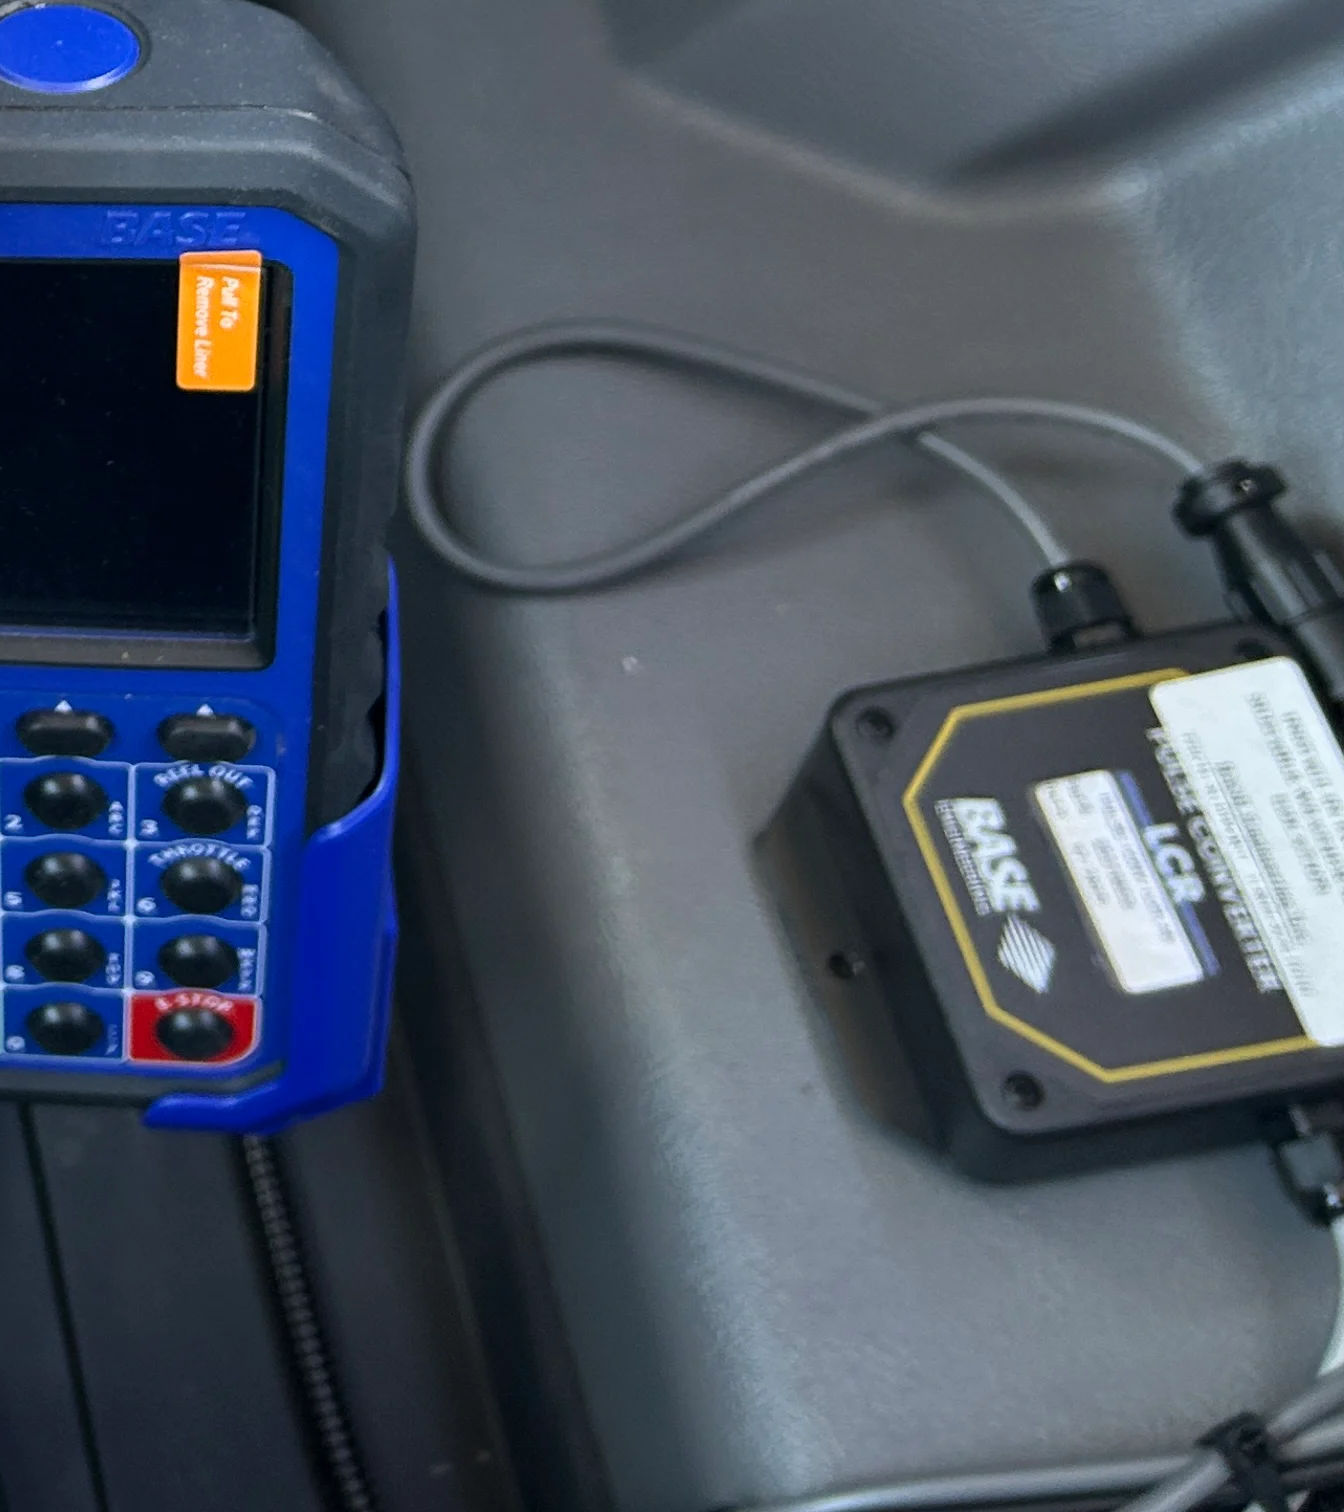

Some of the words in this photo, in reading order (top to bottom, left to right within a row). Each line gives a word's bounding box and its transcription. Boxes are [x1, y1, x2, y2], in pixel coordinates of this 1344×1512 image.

[100, 210, 246, 247] BASE
[194, 276, 214, 336] Remove
[220, 276, 240, 308] Pull
[219, 310, 238, 330] To
[192, 338, 212, 378] Liner
[4, 814, 23, 831] 2
[140, 818, 159, 836] 3
[148, 842, 252, 871] THROTTLE
[952, 797, 1041, 915] BASE
[1141, 823, 1207, 906] LCR
[4, 891, 23, 907] 5
[136, 896, 157, 915] 6
